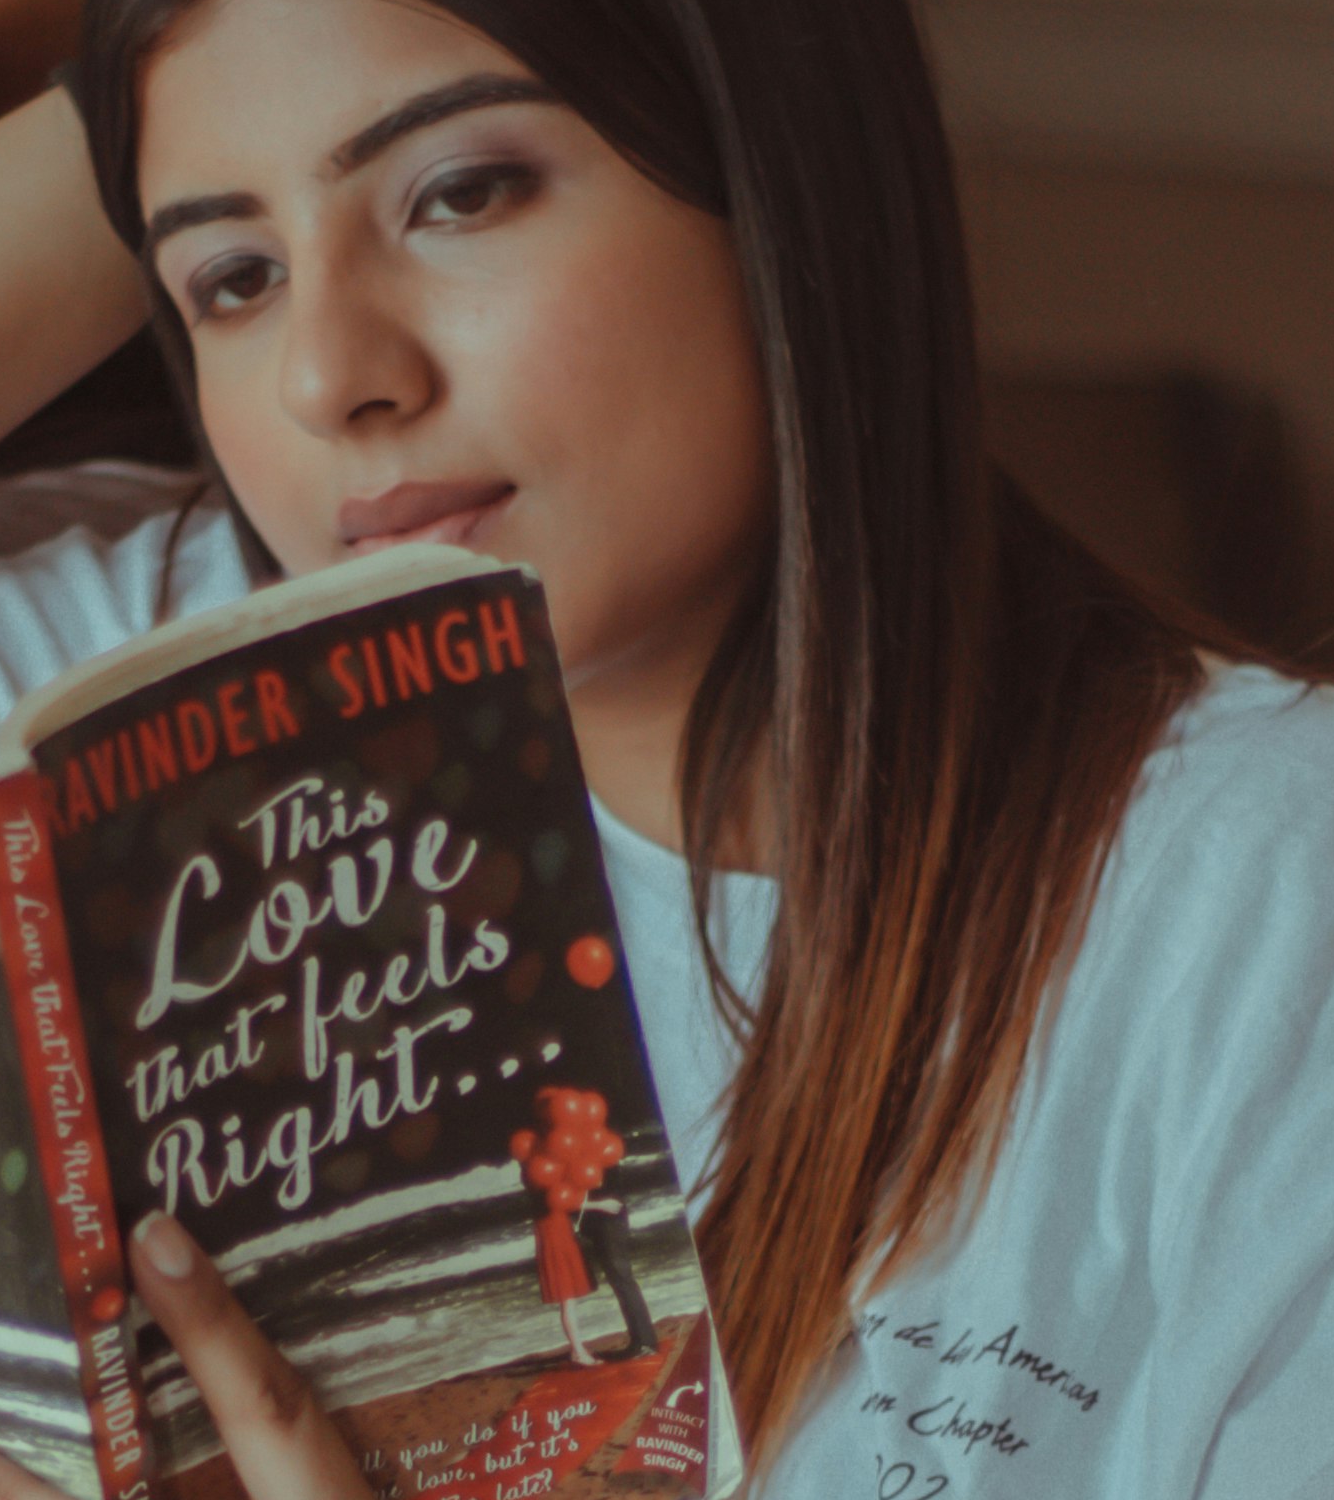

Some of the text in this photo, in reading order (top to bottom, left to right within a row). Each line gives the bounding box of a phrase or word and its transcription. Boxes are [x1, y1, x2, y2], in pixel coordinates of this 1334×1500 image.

[328, 596, 526, 720] SINGH
[3, 804, 41, 884] This
[238, 777, 389, 869] This
[14, 894, 50, 978] Love
[135, 819, 477, 1031] Love
[126, 904, 510, 1122] that feels
[91, 1325, 142, 1471] RAVINDER
[400, 1439, 449, 1471] you
[463, 1423, 496, 1446] do
[511, 1409, 532, 1439] if
[547, 1400, 597, 1431] you
[651, 1407, 705, 1428] INTERACT
[658, 1423, 688, 1438] WITH
[907, 1396, 1029, 1455] Chapter
[417, 1466, 475, 1492] love,
[485, 1440, 535, 1473] but
[541, 1428, 579, 1459] it's
[636, 1437, 704, 1465] RAVINDER
[643, 1453, 687, 1473] SINGH
